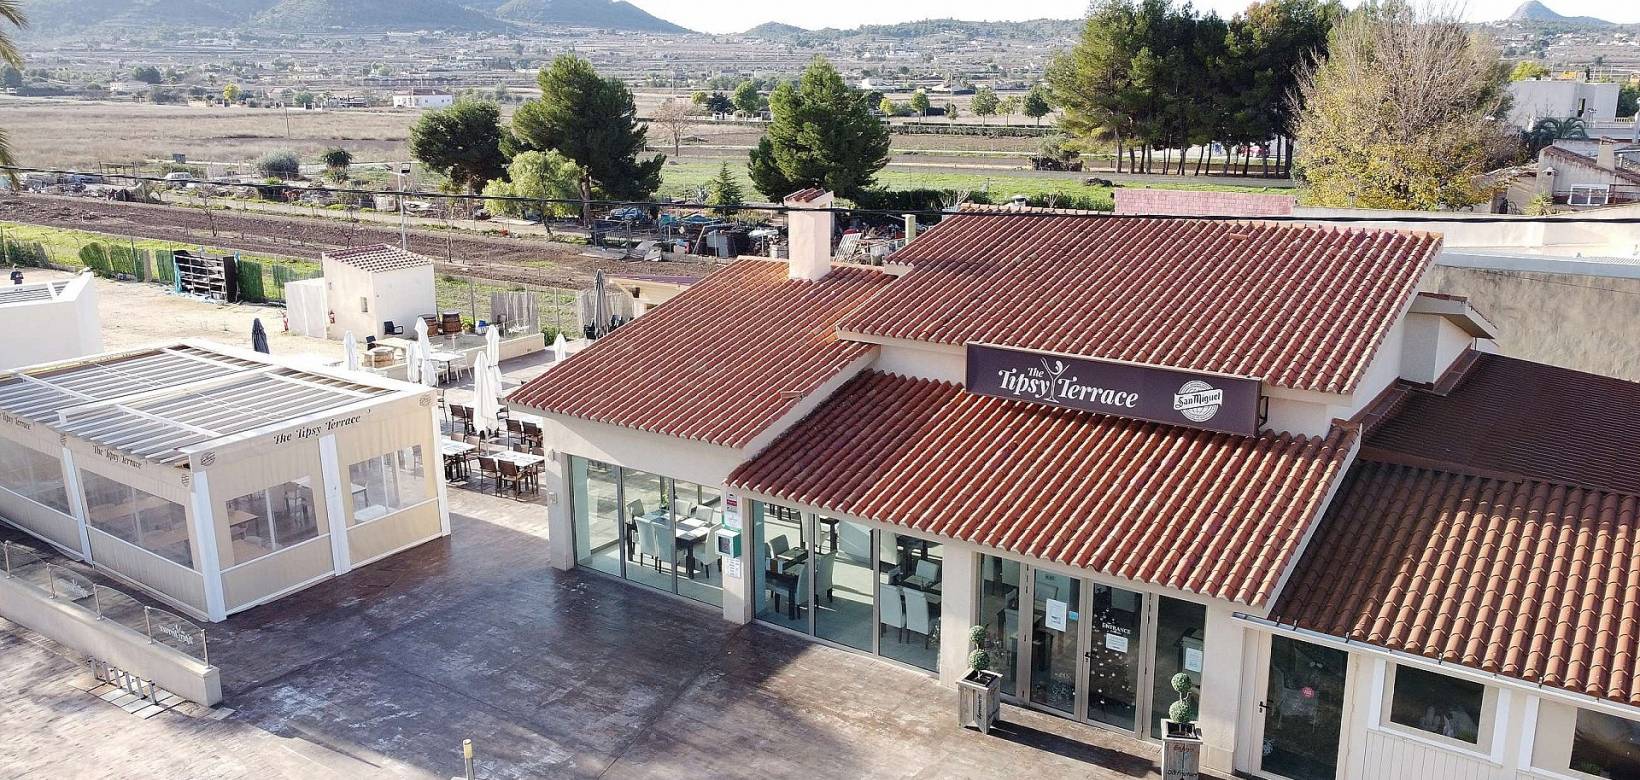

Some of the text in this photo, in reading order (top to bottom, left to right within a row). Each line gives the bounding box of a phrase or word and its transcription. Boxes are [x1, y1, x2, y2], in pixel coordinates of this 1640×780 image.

[1027, 367, 1044, 378] The
[998, 367, 1139, 408] Tipsy Terrace
[274, 415, 361, 445] The Tipsy Terrace
[1101, 622, 1132, 635] ENTRANCE
